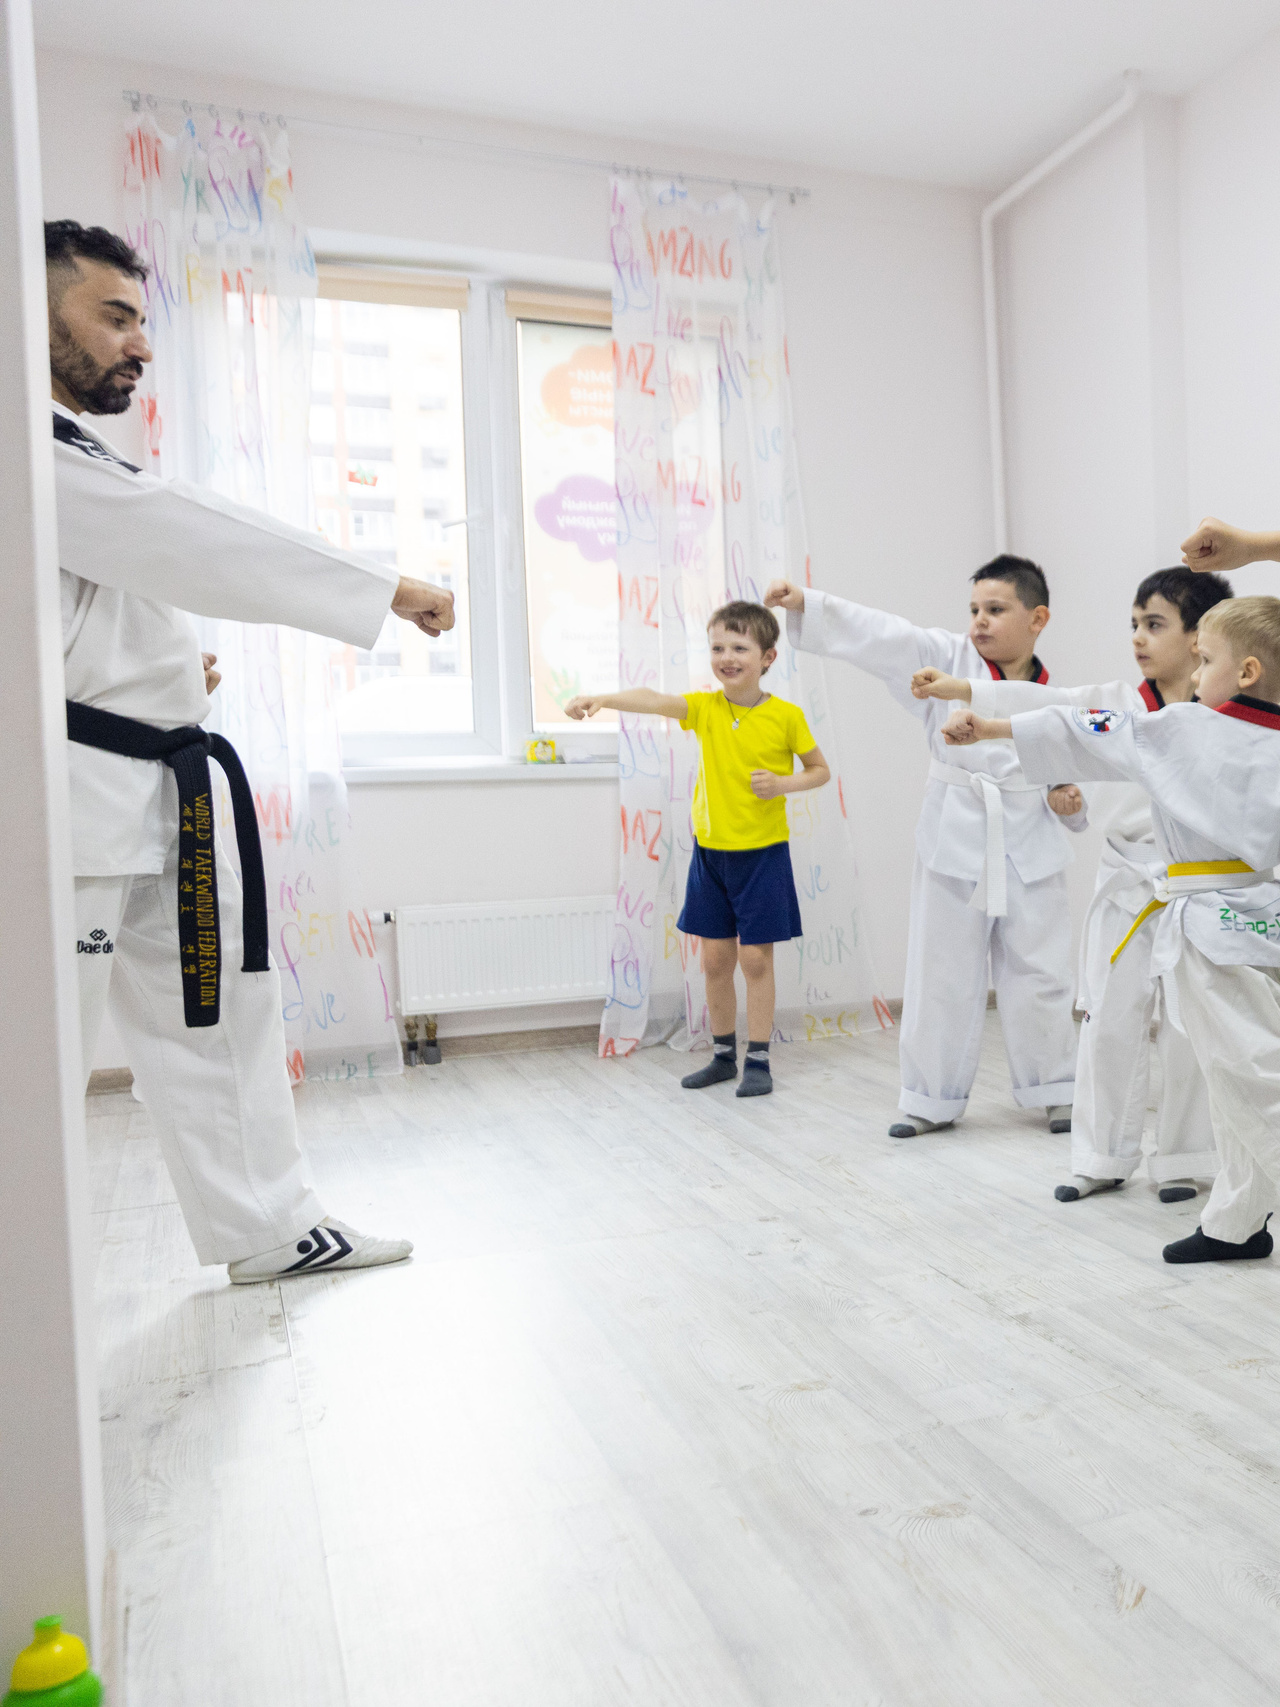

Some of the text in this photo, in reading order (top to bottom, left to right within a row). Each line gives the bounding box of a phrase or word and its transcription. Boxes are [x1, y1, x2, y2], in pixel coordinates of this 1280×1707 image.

[195, 793, 217, 1006] WORLD TAEKWONDO FEDERATION
